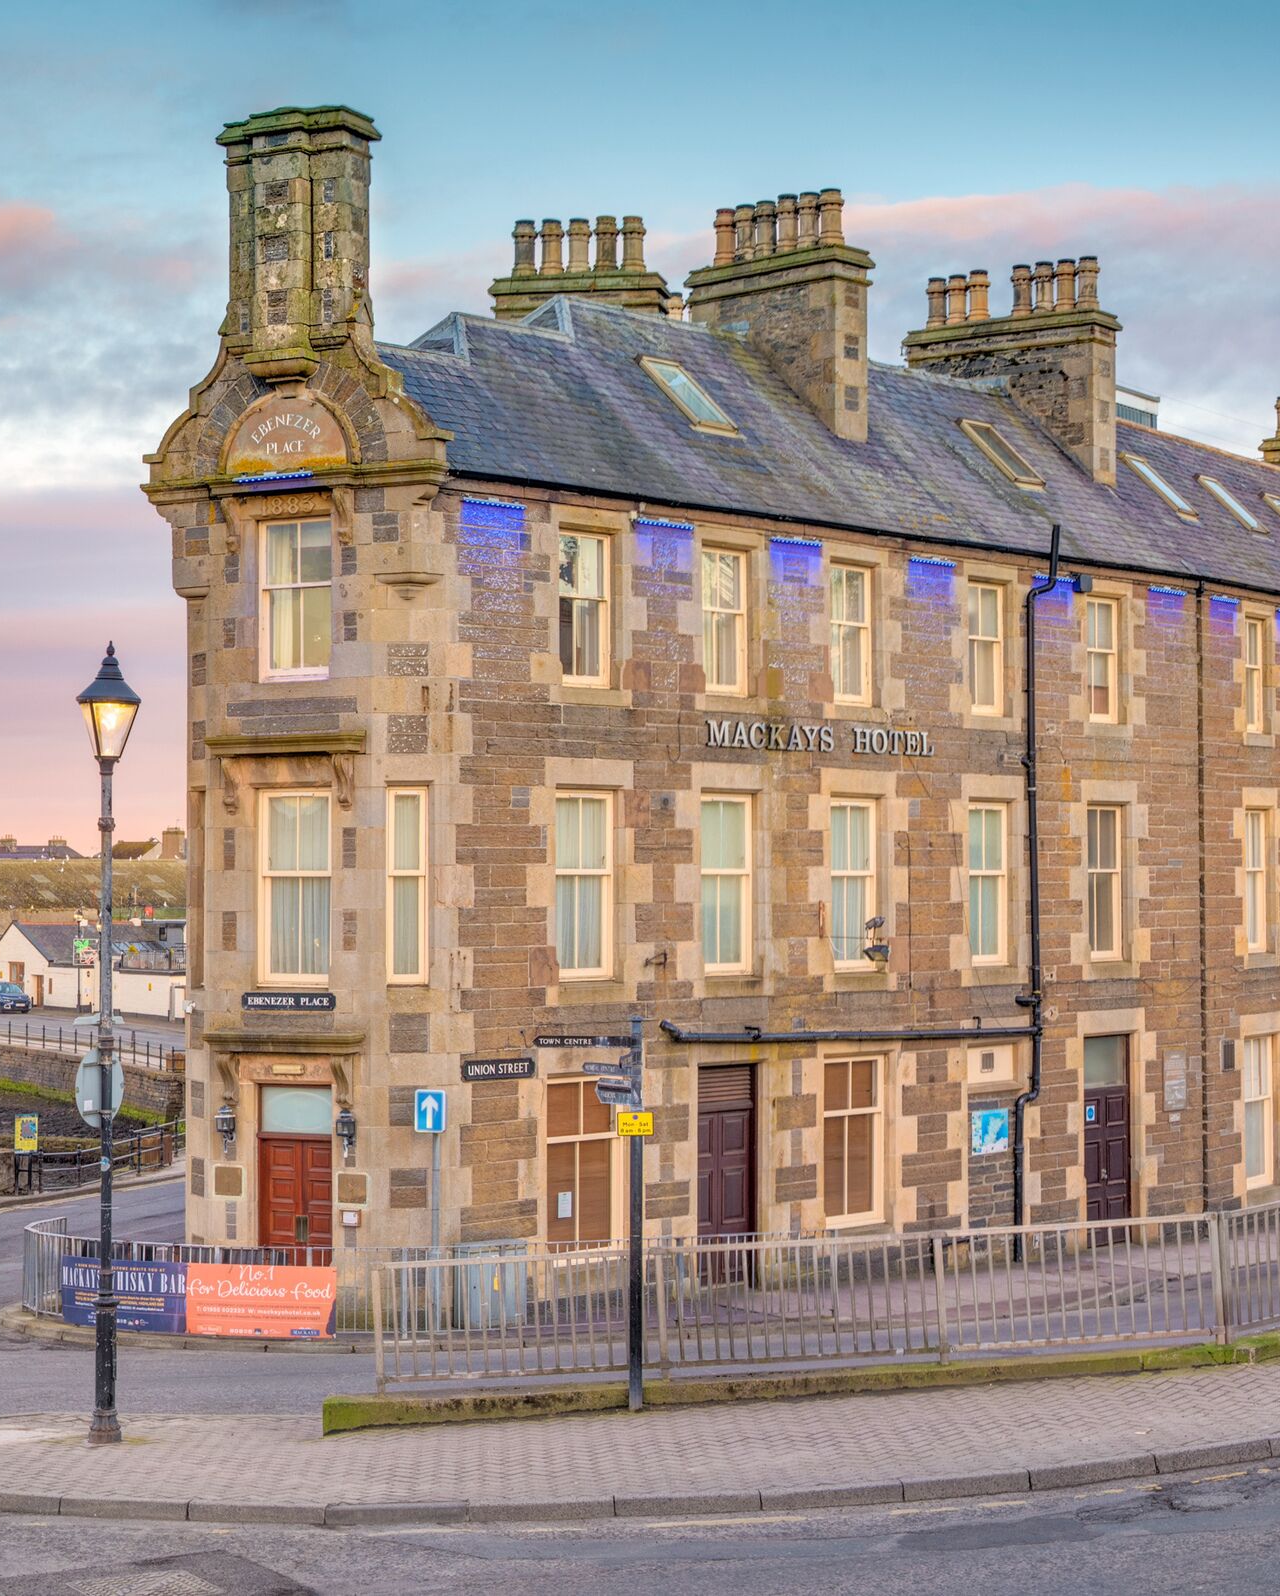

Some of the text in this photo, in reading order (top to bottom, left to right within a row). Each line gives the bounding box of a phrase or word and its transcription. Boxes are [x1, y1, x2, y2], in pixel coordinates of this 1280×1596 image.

[251, 413, 321, 445] EBENEZER
[266, 439, 305, 455] PLACE
[261, 494, 316, 516] 1883
[706, 718, 935, 757] MACKAYS HOTEL
[247, 997, 330, 1006] EBENEZER PLACE
[467, 1062, 530, 1076] UNION STREET
[239, 1264, 274, 1282] No.1
[160, 1273, 186, 1294] BAR
[217, 1280, 288, 1298] Delicious
